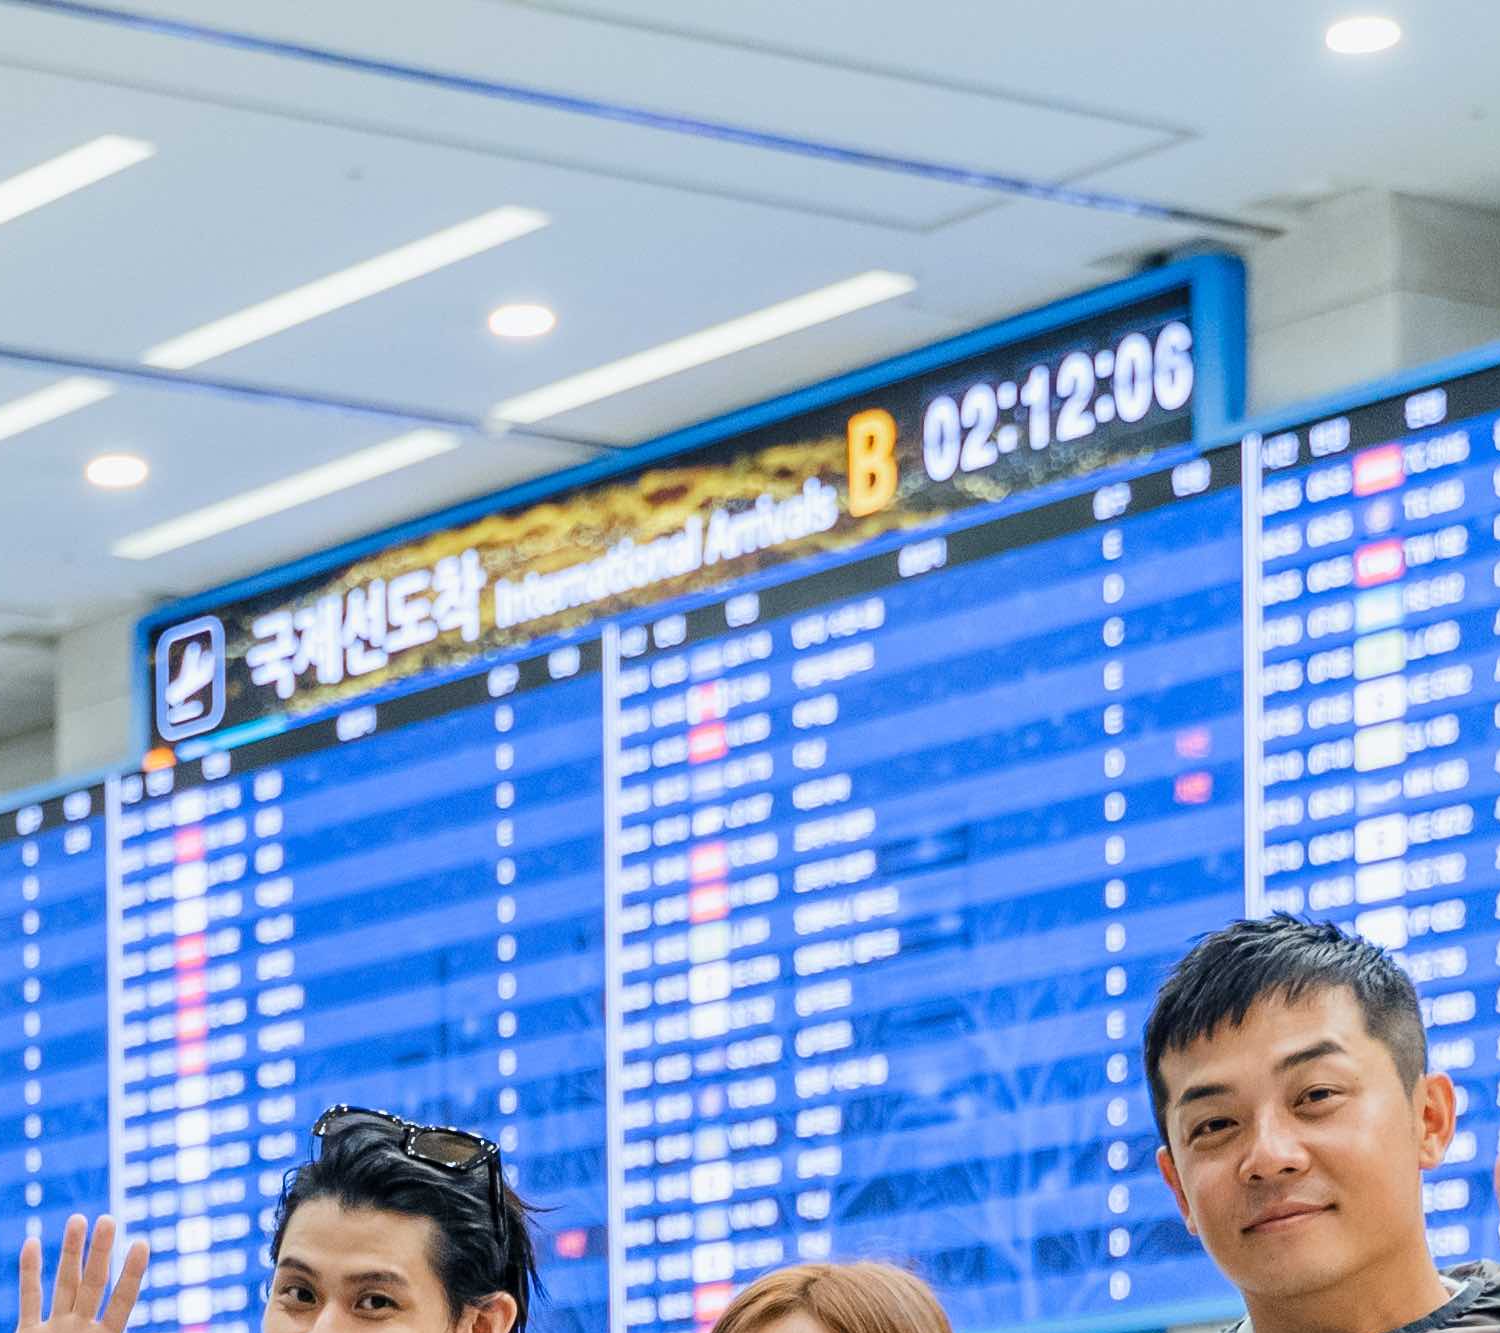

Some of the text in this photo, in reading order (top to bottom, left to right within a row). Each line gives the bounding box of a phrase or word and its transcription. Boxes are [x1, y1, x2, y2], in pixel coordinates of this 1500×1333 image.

[246, 320, 1195, 700] 국제선도착 International Arrivals B 02:12:06
